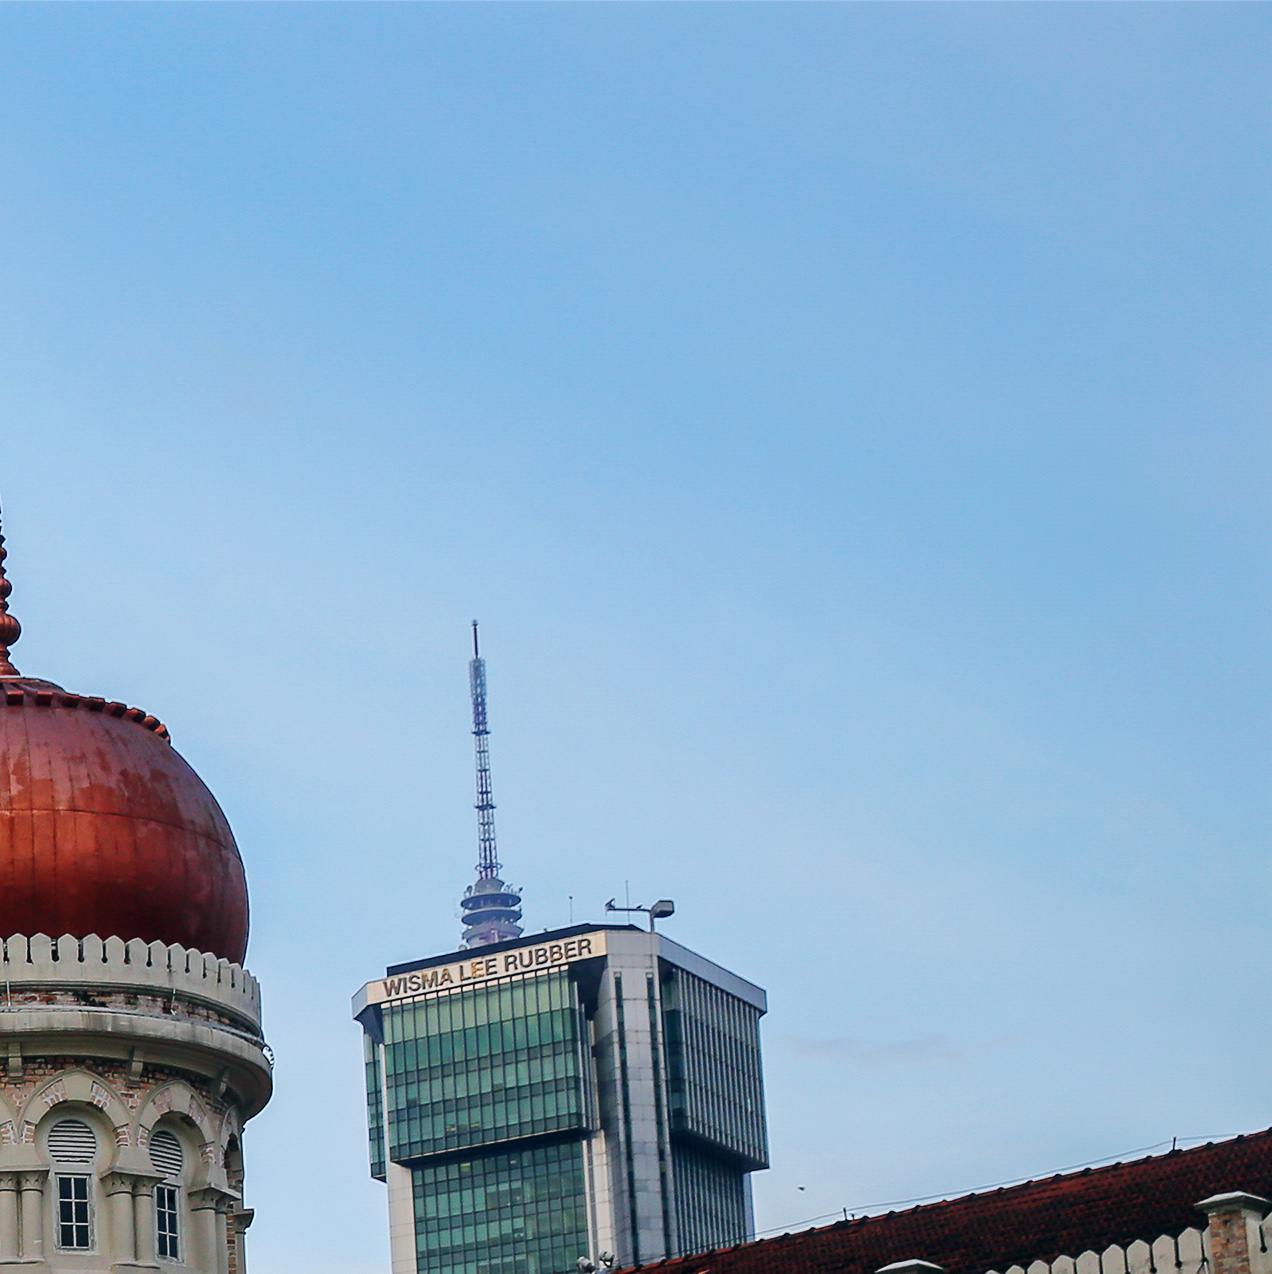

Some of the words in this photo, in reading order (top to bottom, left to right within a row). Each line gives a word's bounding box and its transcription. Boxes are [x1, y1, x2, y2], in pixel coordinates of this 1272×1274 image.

[383, 967, 454, 997] WISMA
[459, 957, 498, 982] LEE
[504, 938, 592, 972] RUBBER
